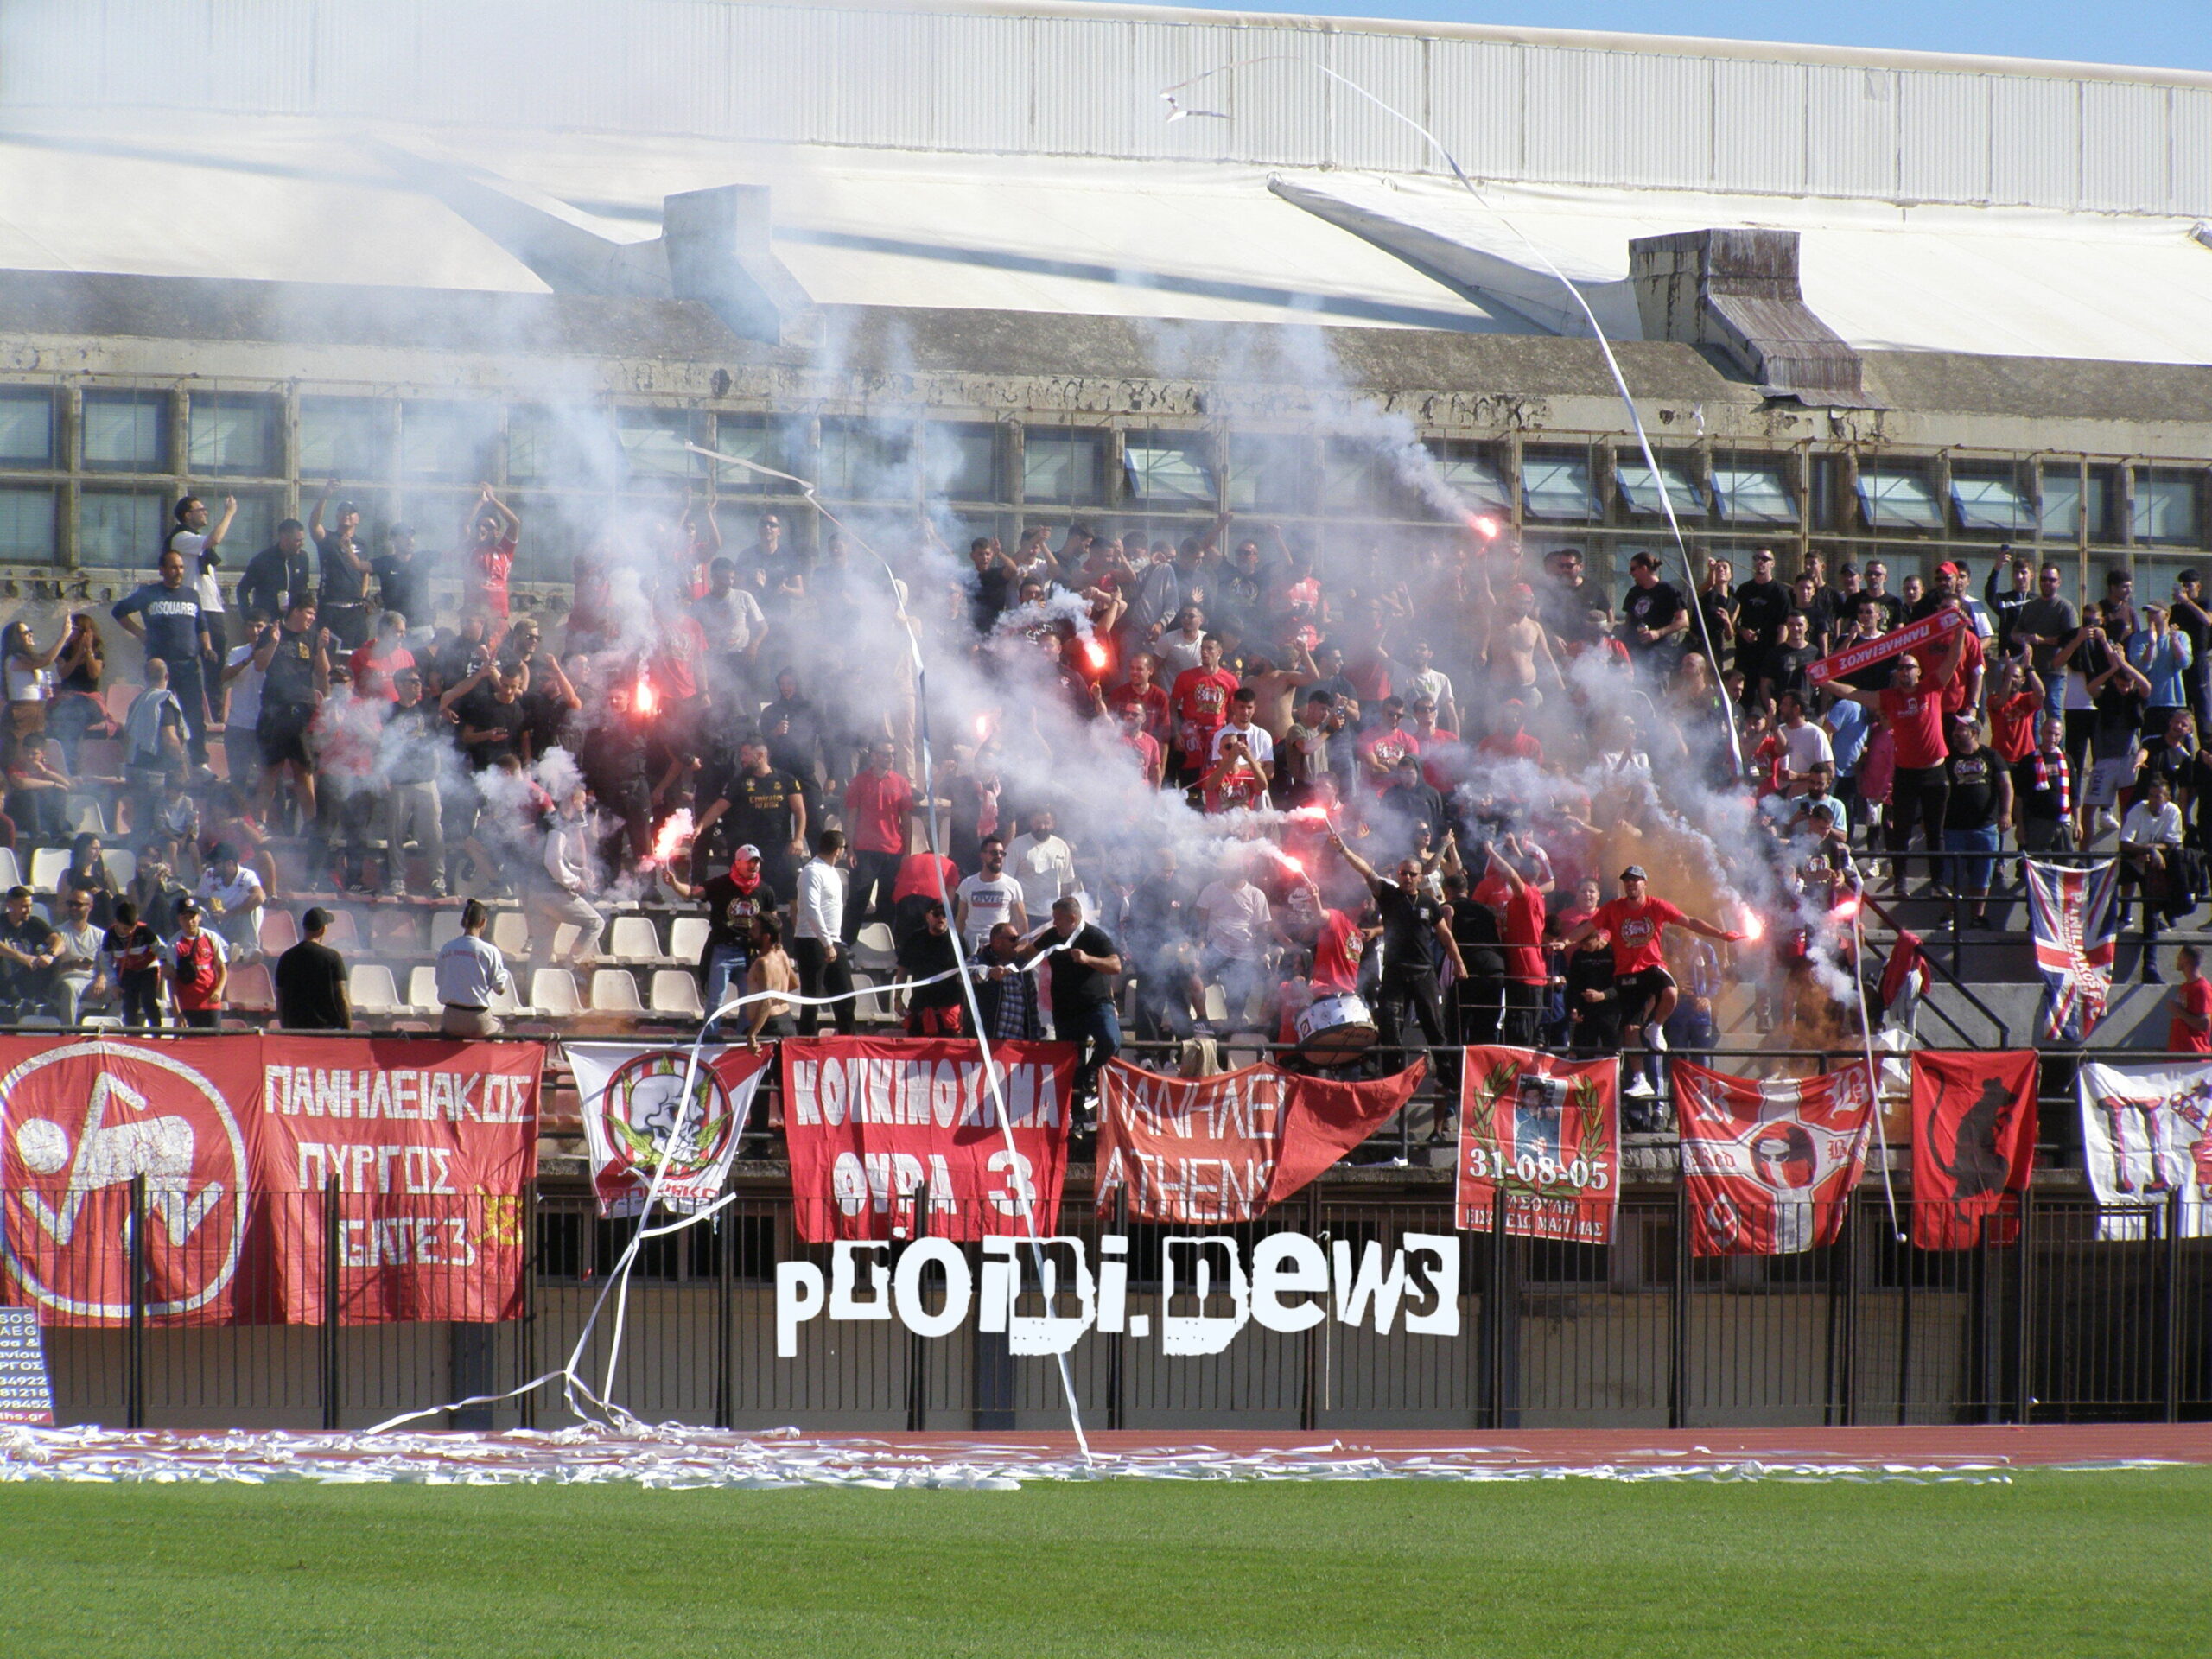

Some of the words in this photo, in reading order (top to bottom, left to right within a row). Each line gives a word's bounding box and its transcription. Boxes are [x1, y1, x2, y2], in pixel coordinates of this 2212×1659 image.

[1839, 624, 1930, 670] ΠΑΝΗΛΕΙΑΚΟΣ
[265, 1065, 534, 1123] ΠΑΝΗΛΕΙΑΚΟΣ
[298, 1142, 455, 1195] ΠΥΡΓΟΣ
[1469, 1147, 1609, 1190] 31-08-05
[1691, 1146, 1736, 1167] Red
[987, 1150, 1036, 1217] 3
[1507, 1195, 1575, 1216] ΑΣΟΥΛΗ
[26, 1338, 39, 1347] &
